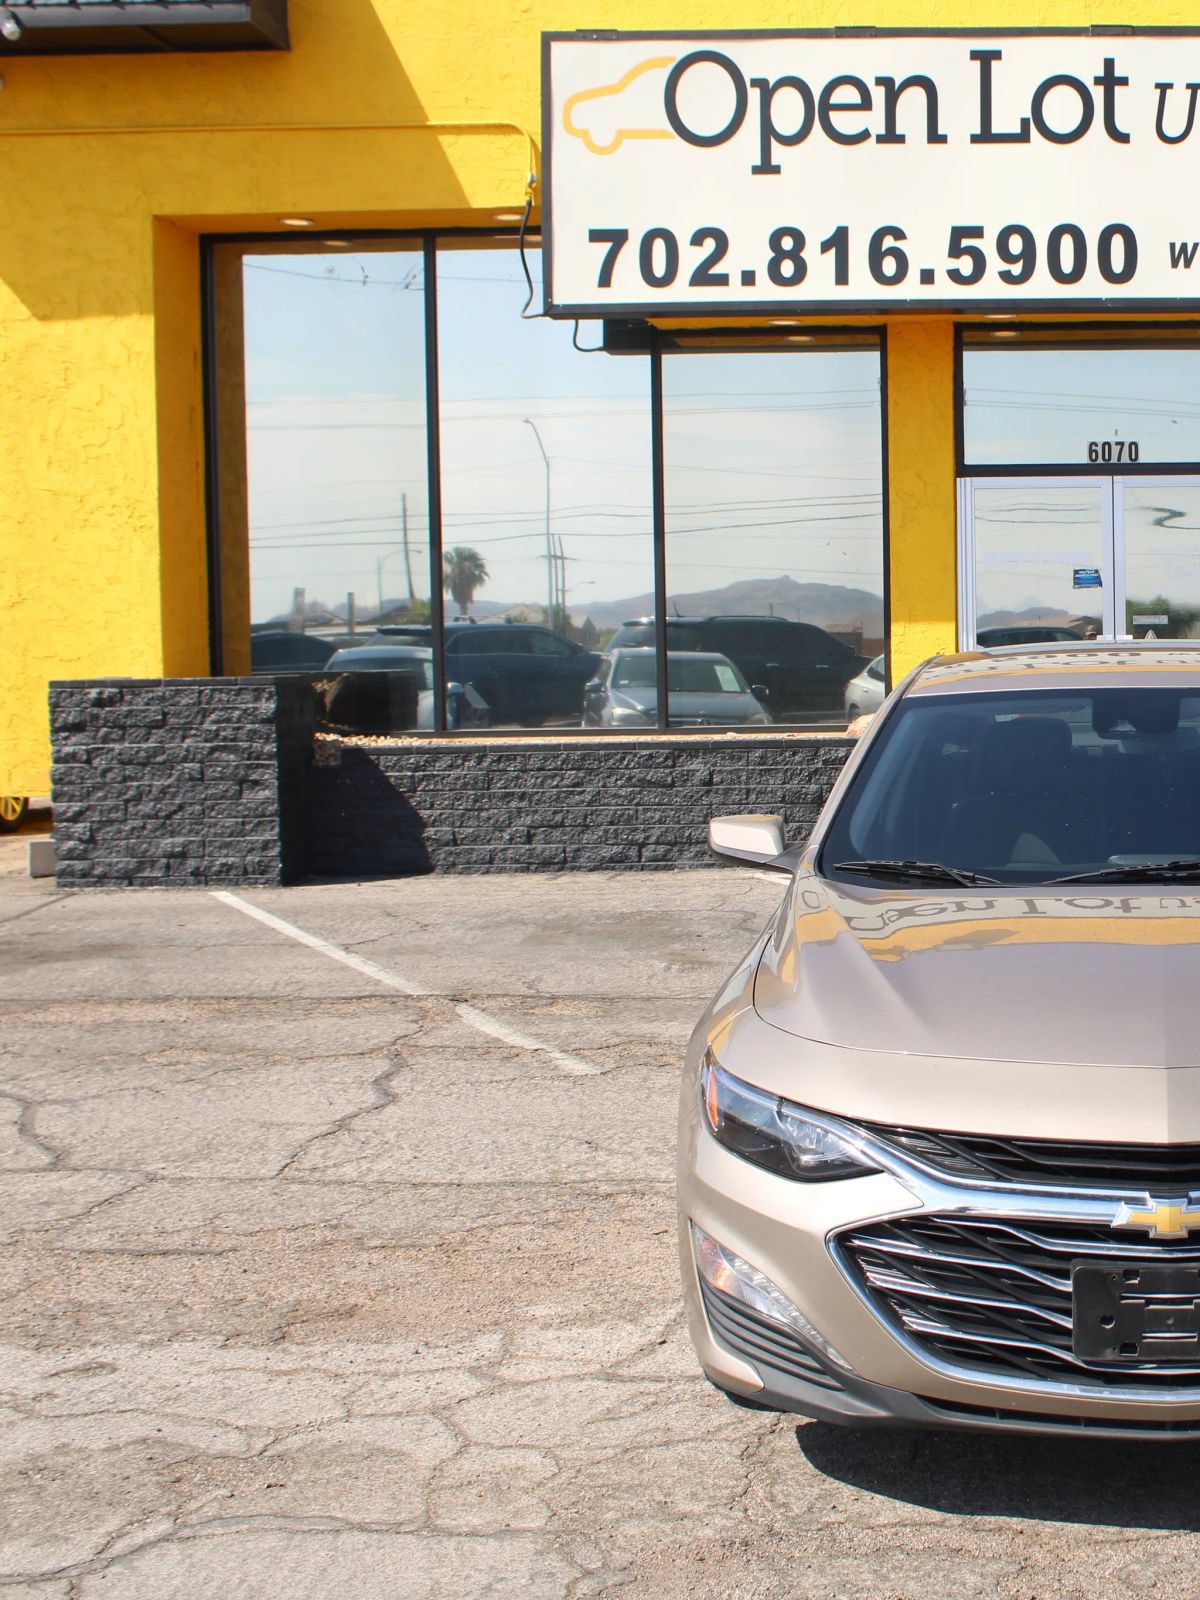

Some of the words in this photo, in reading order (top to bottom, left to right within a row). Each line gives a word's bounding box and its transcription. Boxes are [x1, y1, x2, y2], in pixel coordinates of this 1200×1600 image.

[664, 50, 948, 175] Open
[969, 49, 1131, 145] Lot
[588, 223, 1138, 288] 702.816.5900
[1088, 441, 1139, 463] 6070
